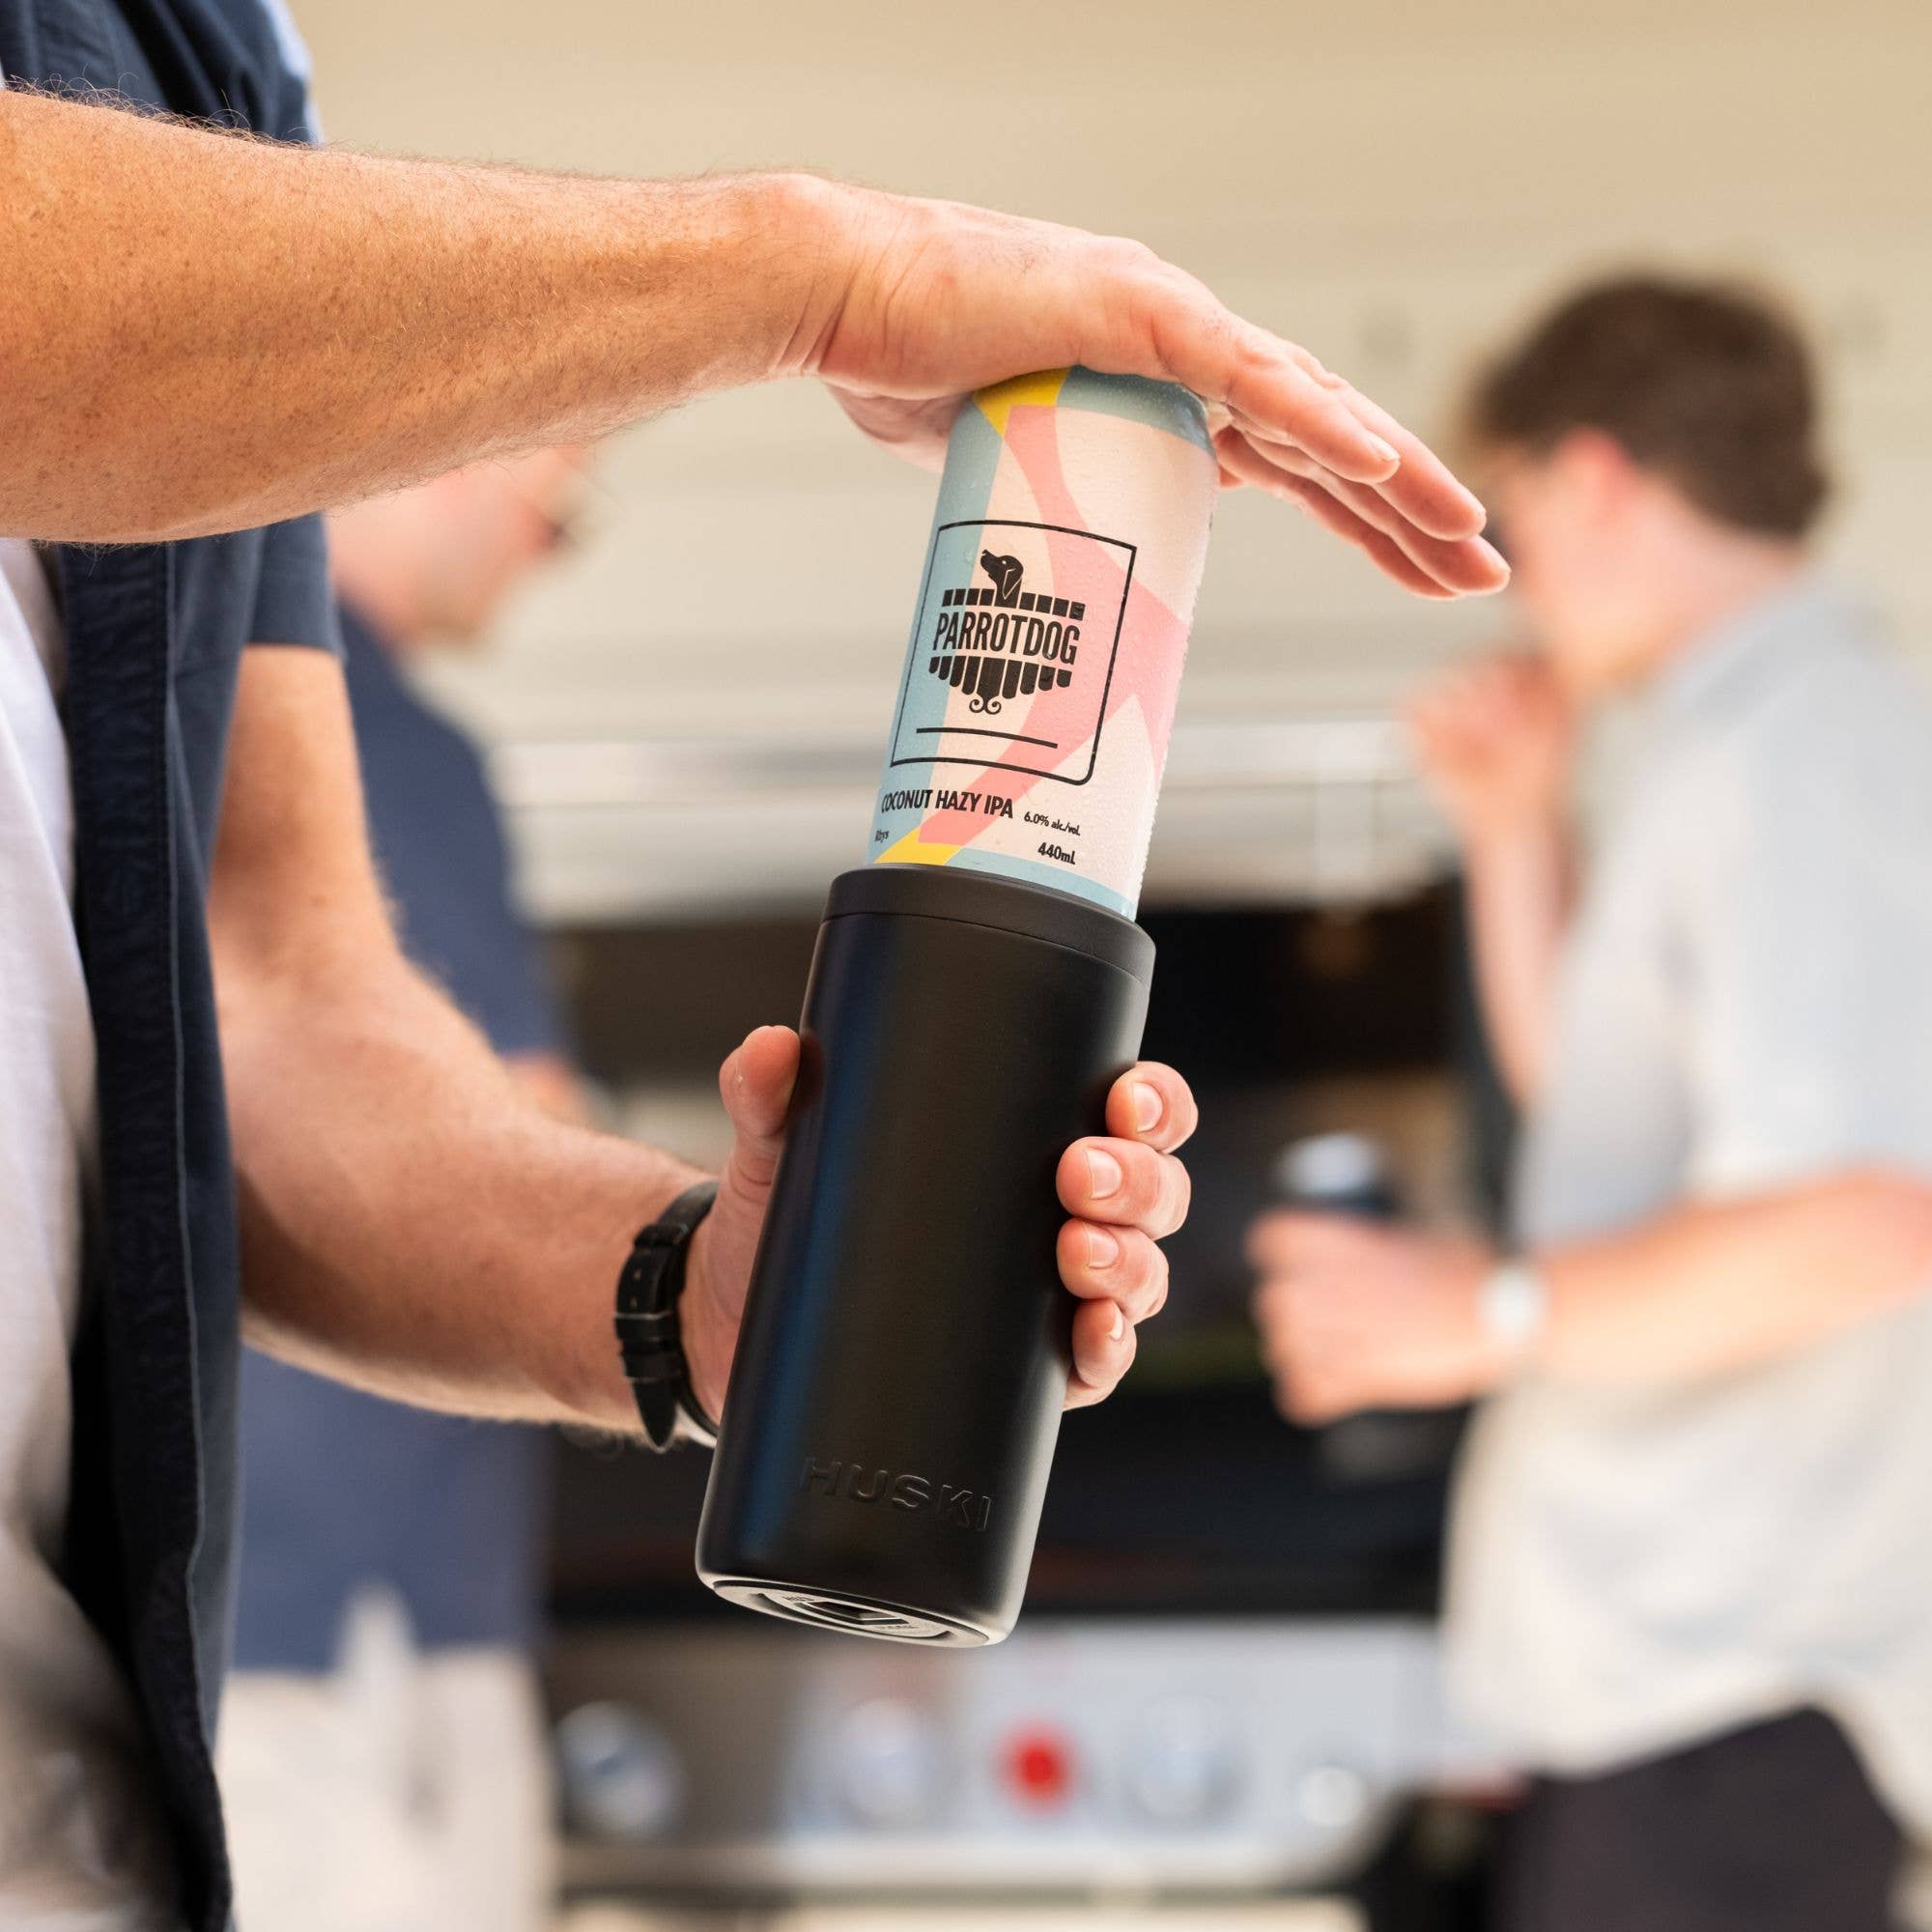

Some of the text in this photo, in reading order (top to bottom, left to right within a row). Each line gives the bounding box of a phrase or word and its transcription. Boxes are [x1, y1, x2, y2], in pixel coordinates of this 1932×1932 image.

[931, 611, 1081, 666] PARROTDOG
[881, 789, 1013, 819] COCONUT HAZY IPA
[1024, 810, 1050, 827] 6.0%
[800, 1456, 992, 1533] HUSKI
